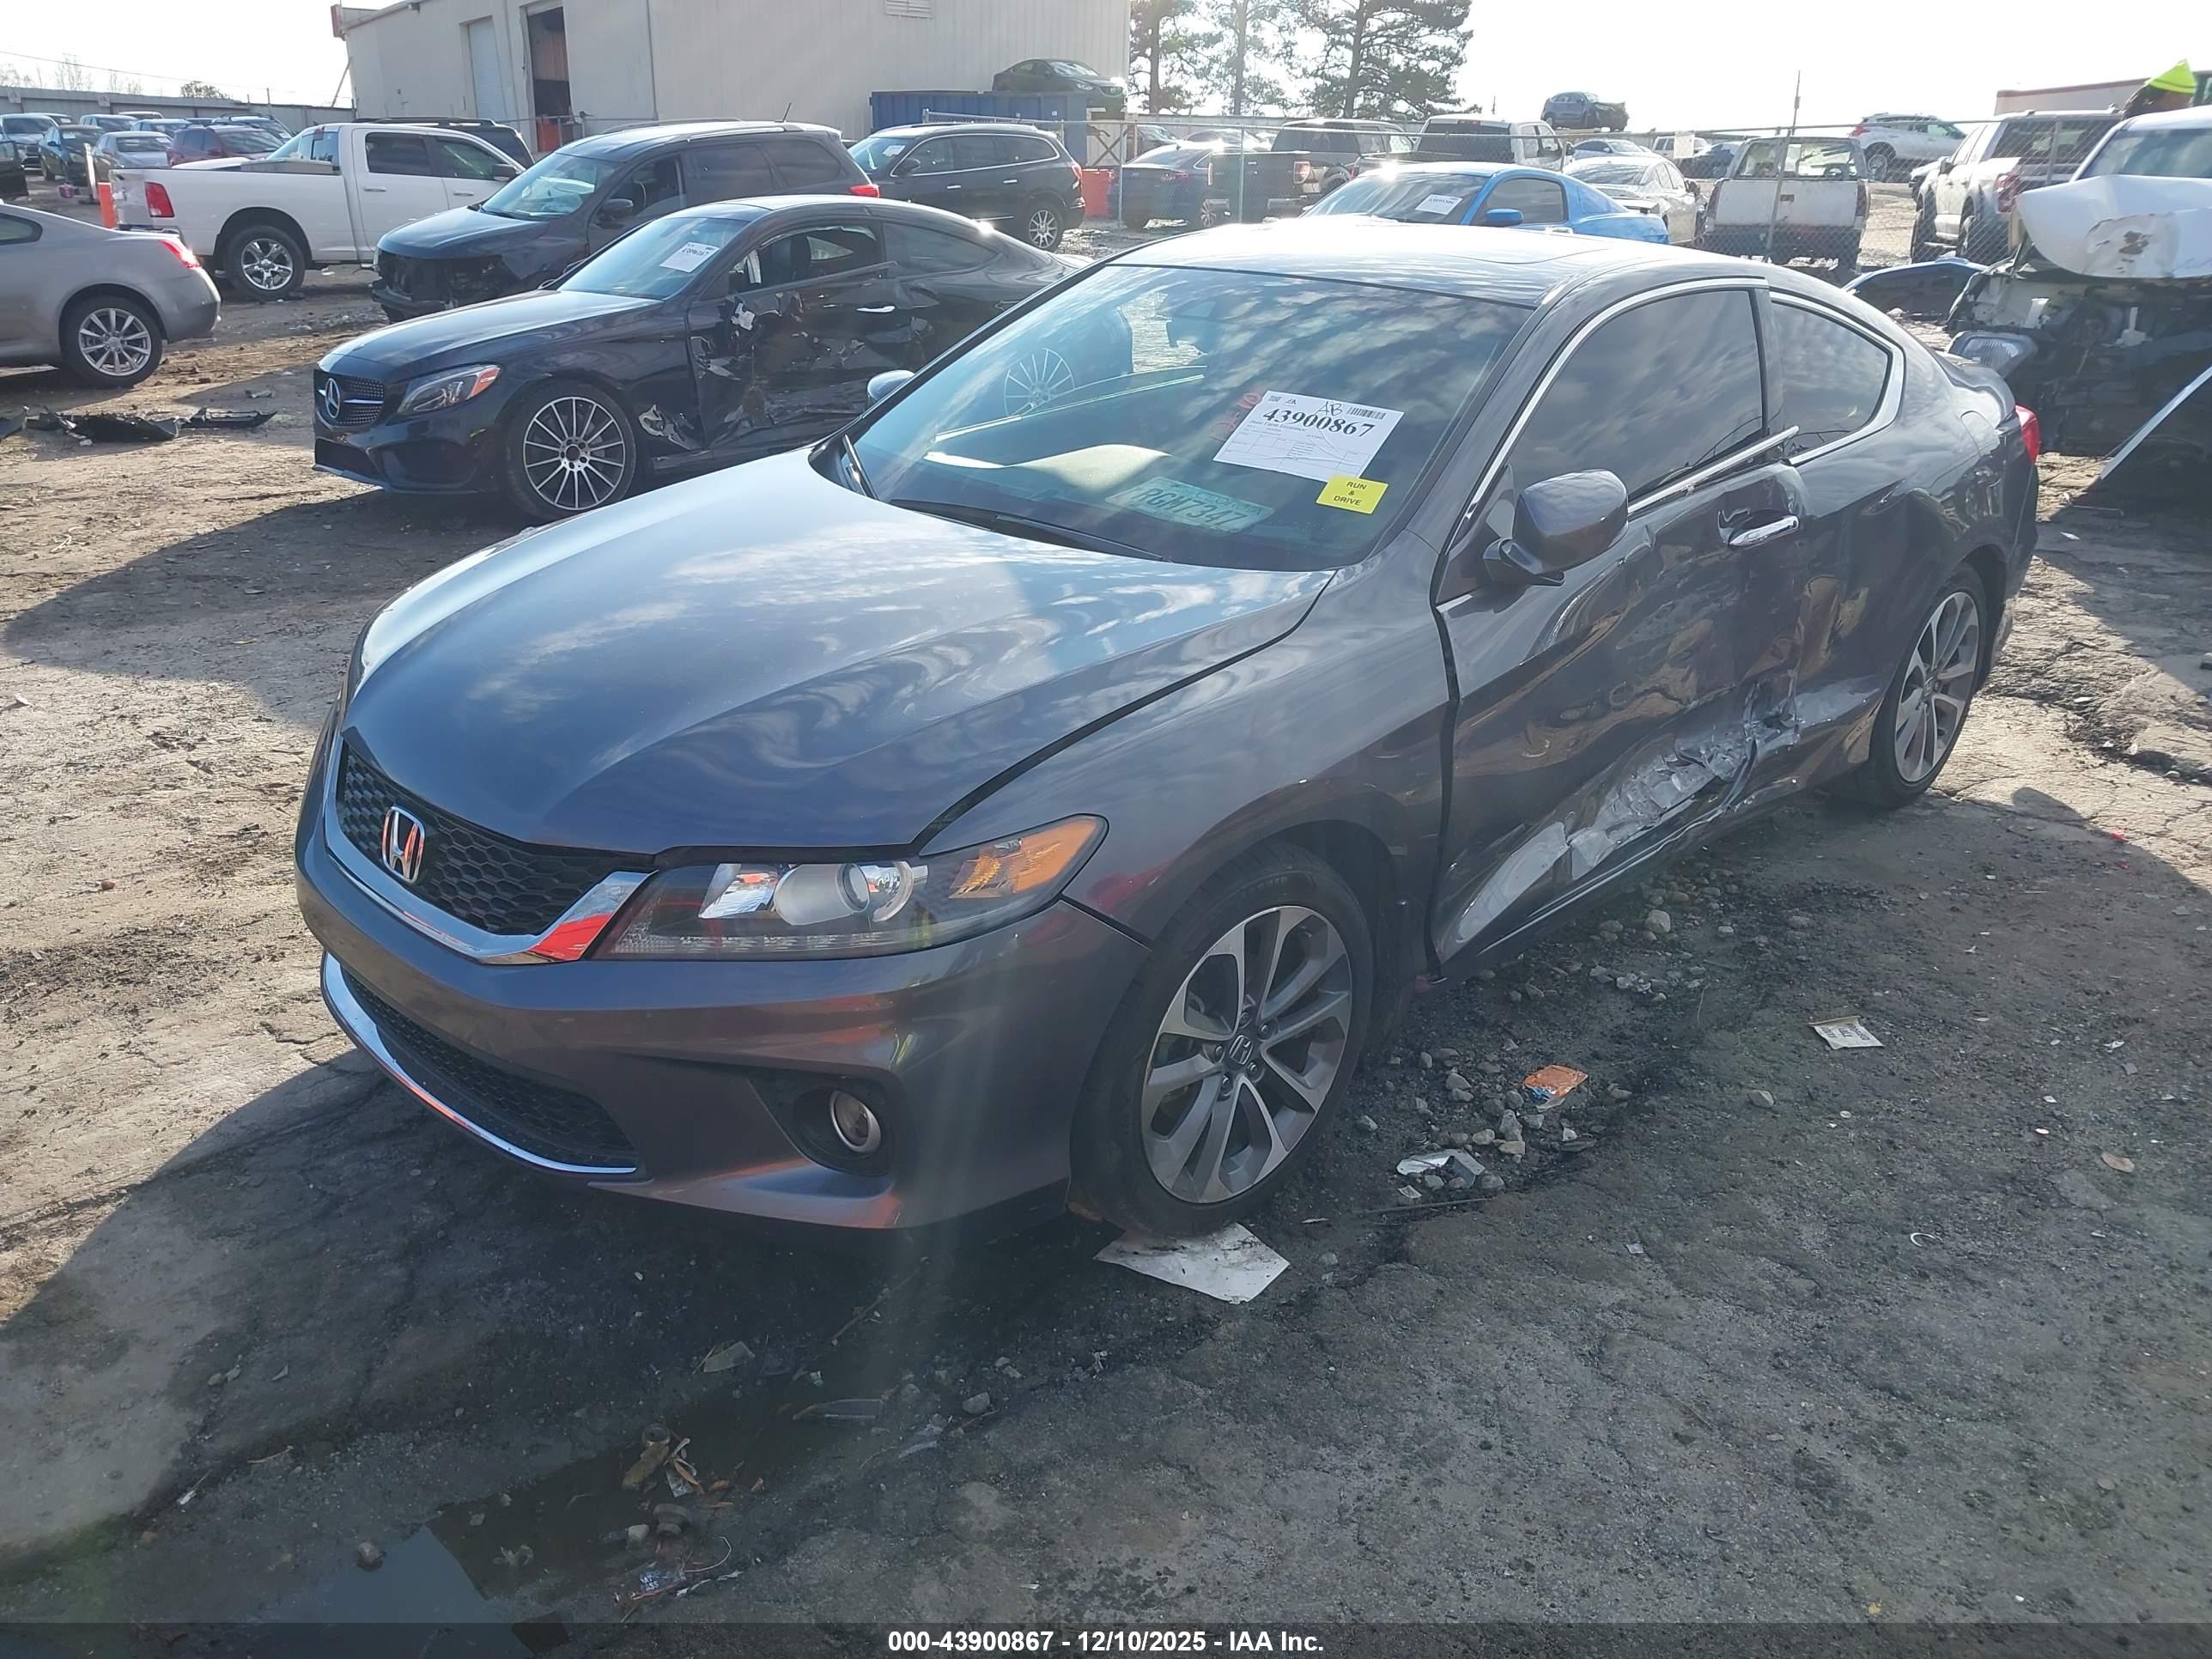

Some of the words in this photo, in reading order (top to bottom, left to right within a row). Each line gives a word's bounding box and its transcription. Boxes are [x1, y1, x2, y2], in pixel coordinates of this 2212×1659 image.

[1263, 408, 1376, 437] 43900867
[1346, 481, 1367, 489] RUN
[1334, 495, 1363, 506] DRIVE
